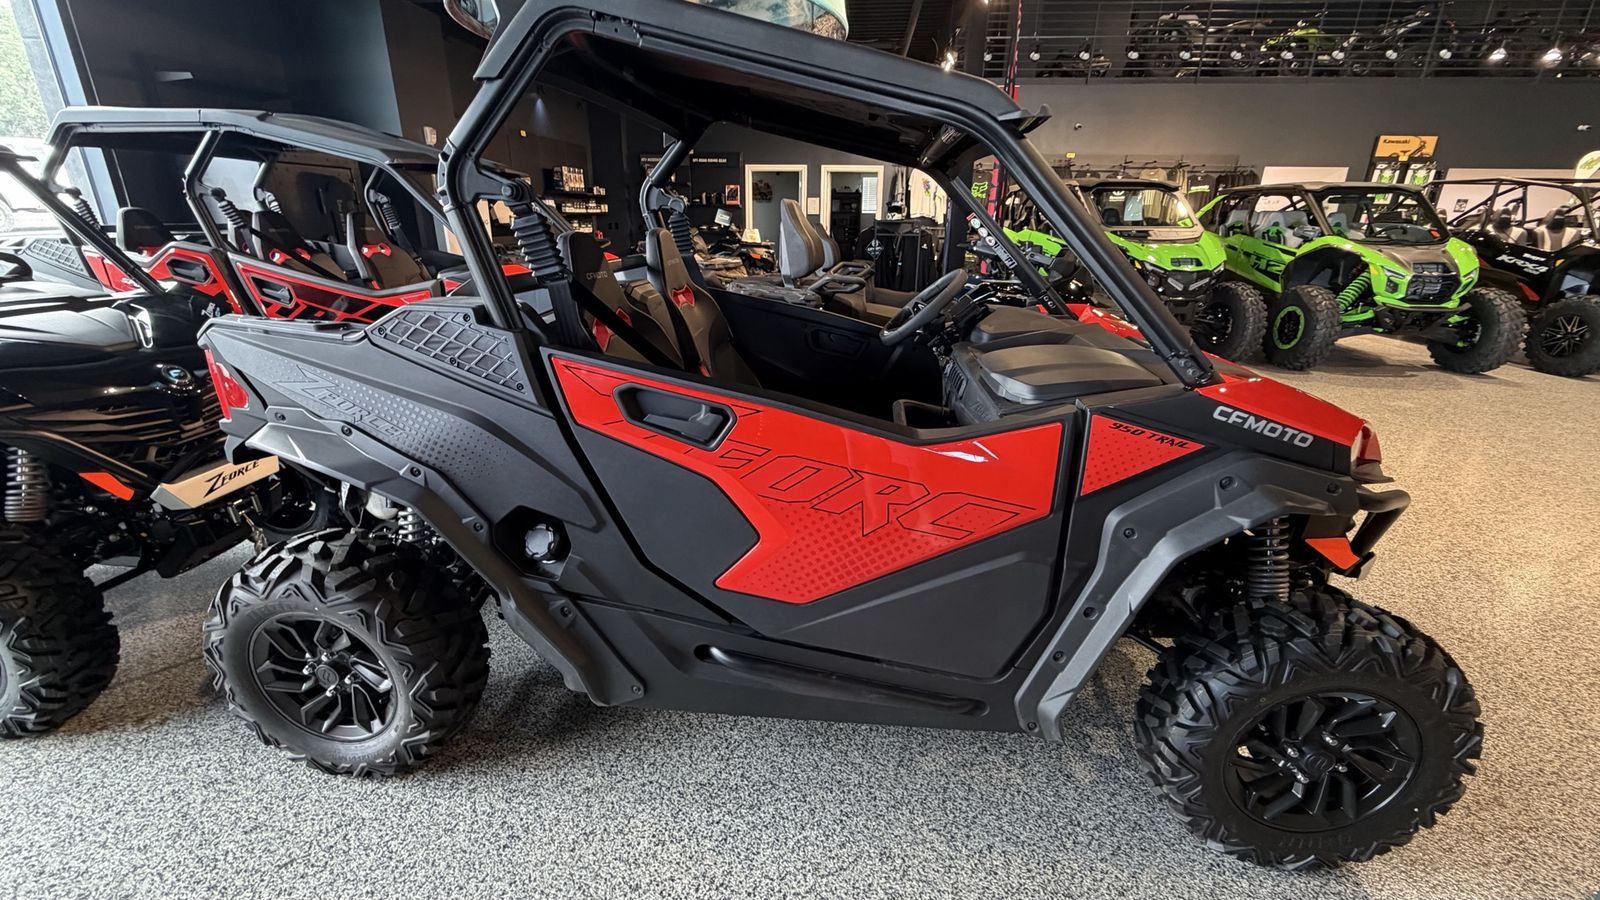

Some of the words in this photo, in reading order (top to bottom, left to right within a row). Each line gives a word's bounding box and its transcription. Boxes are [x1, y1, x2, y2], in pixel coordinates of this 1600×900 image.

[1108, 422, 1146, 436] 950
[1146, 432, 1190, 449] TRAIL
[1212, 405, 1314, 448] CFMOTO
